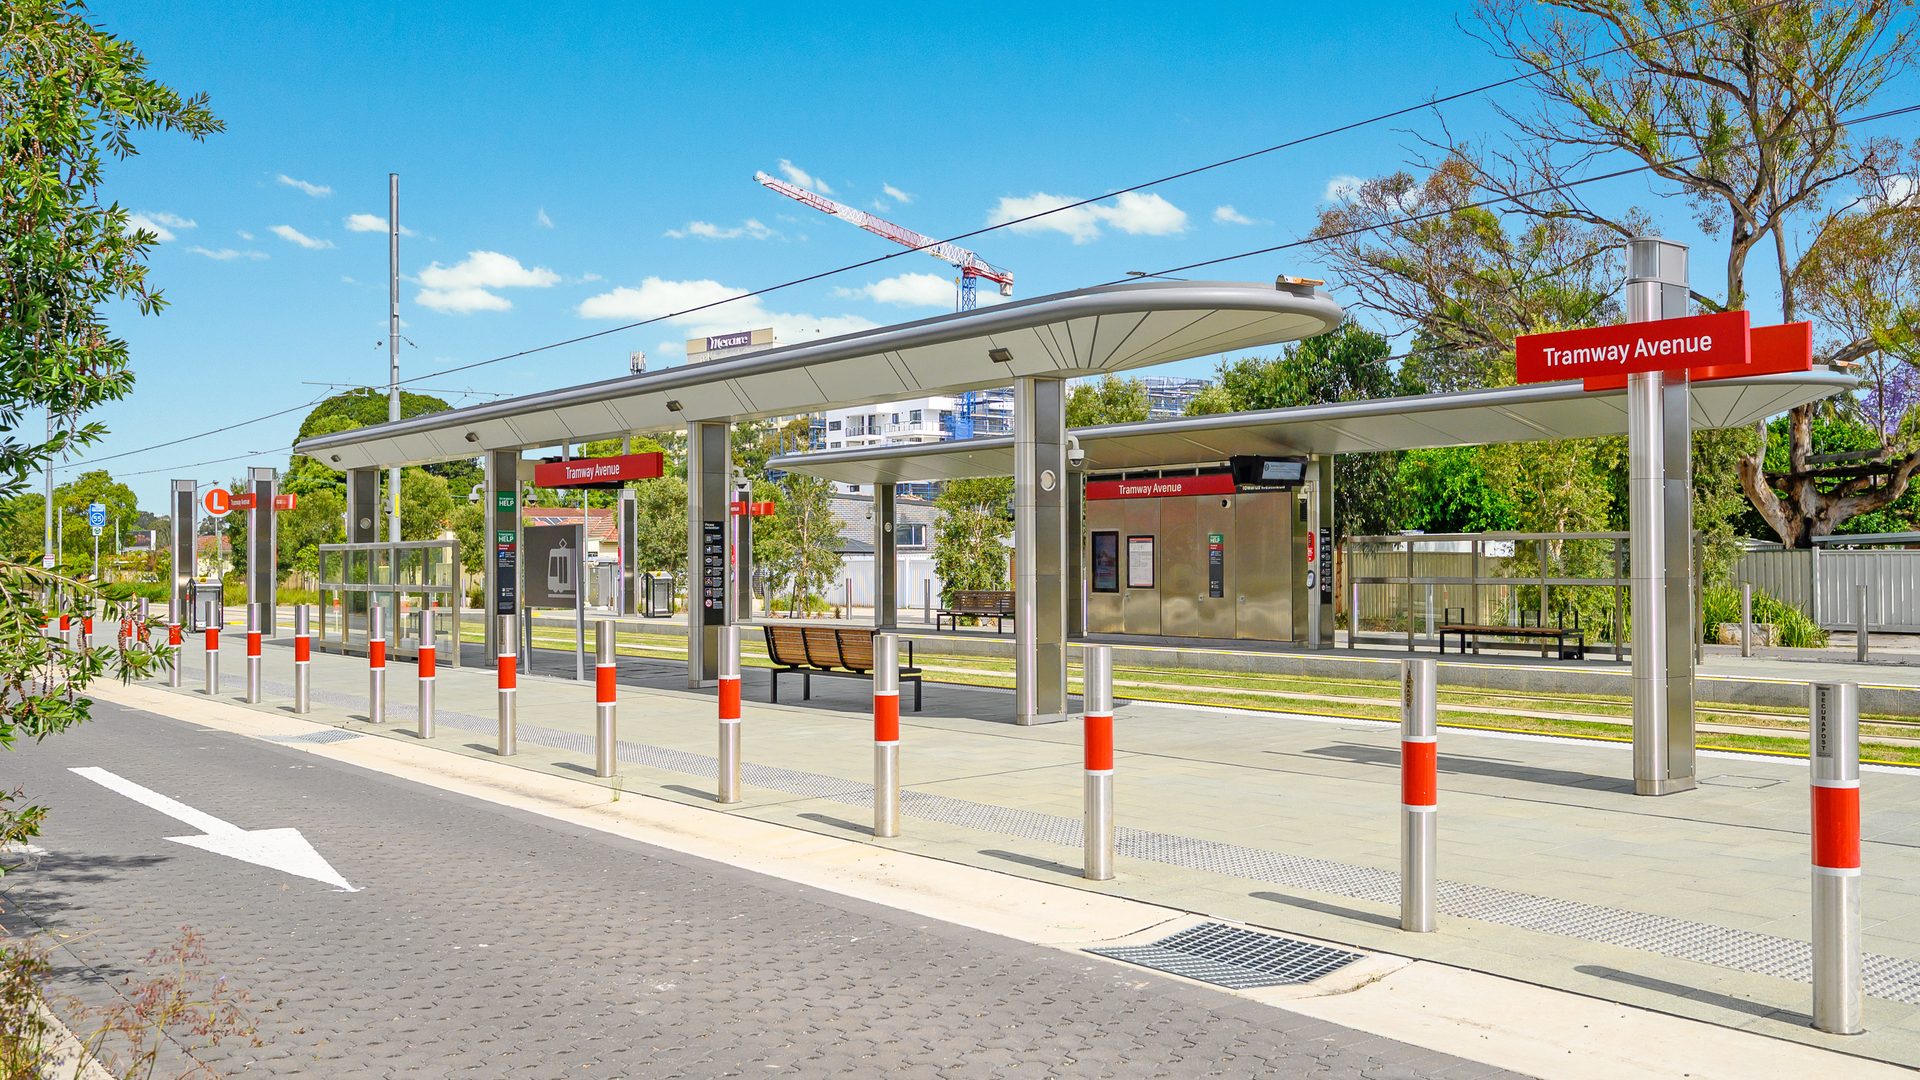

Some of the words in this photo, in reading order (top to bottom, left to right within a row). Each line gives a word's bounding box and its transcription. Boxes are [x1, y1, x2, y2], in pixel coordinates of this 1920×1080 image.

[710, 336, 748, 349] Mercure
[1543, 344, 1630, 367] Tramway
[1634, 335, 1712, 358] Avenue
[565, 466, 594, 480] Tramway
[594, 463, 620, 477] Avenue
[1118, 484, 1152, 496] Tramway
[1152, 483, 1182, 493] Avenue
[213, 492, 225, 510] L
